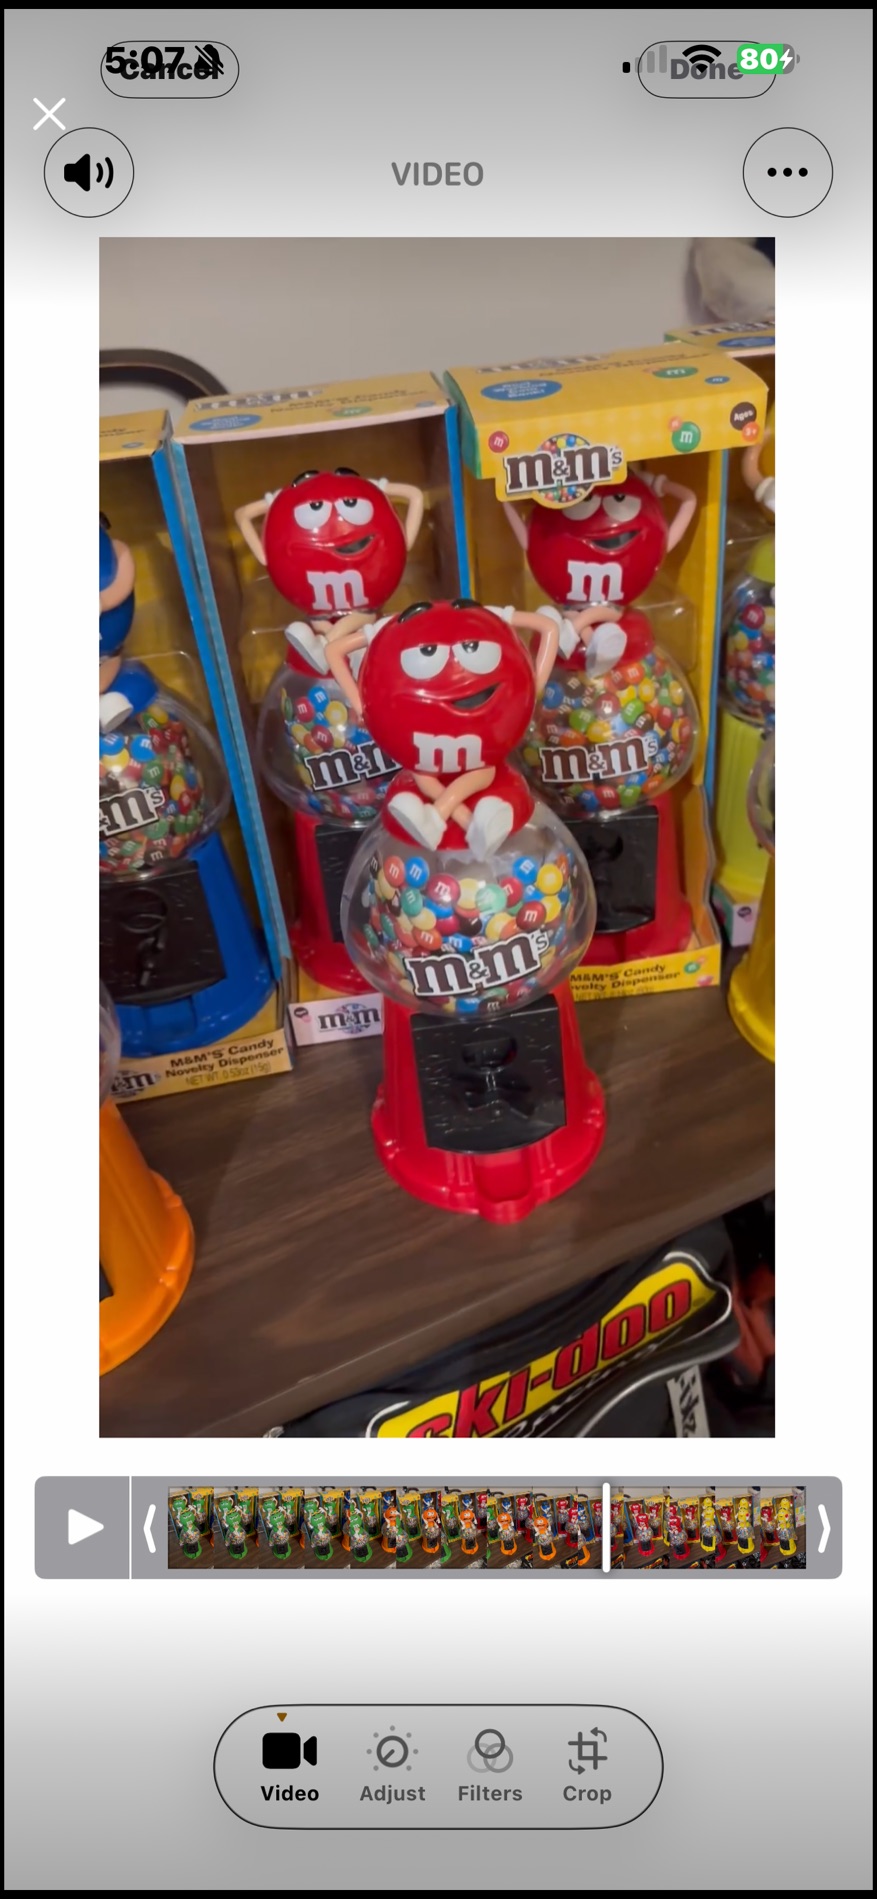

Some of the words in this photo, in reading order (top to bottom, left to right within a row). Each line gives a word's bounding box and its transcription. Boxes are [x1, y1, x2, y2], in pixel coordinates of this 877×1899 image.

[105, 46, 185, 74] 5:07
[120, 57, 219, 80] Cancel
[670, 58, 745, 80] Done
[740, 48, 779, 70] 80
[391, 161, 484, 187] VIDEO
[733, 410, 754, 422] Ages
[493, 436, 505, 448] m
[680, 430, 694, 444] m
[505, 445, 623, 490] m&m's
[306, 569, 370, 611] m
[566, 560, 625, 602] m
[413, 731, 486, 773] m
[540, 736, 659, 781] m&m's
[99, 787, 164, 833] m's
[406, 930, 550, 995] m&m's
[624, 964, 666, 978] Candy
[227, 1038, 274, 1056] Candy
[164, 1062, 215, 1079] Novelty
[218, 1046, 284, 1068] Dispenser
[261, 1784, 320, 1802] Video
[359, 1784, 426, 1805] Adjust
[458, 1784, 523, 1803] Filters
[562, 1785, 613, 1806] Crop
